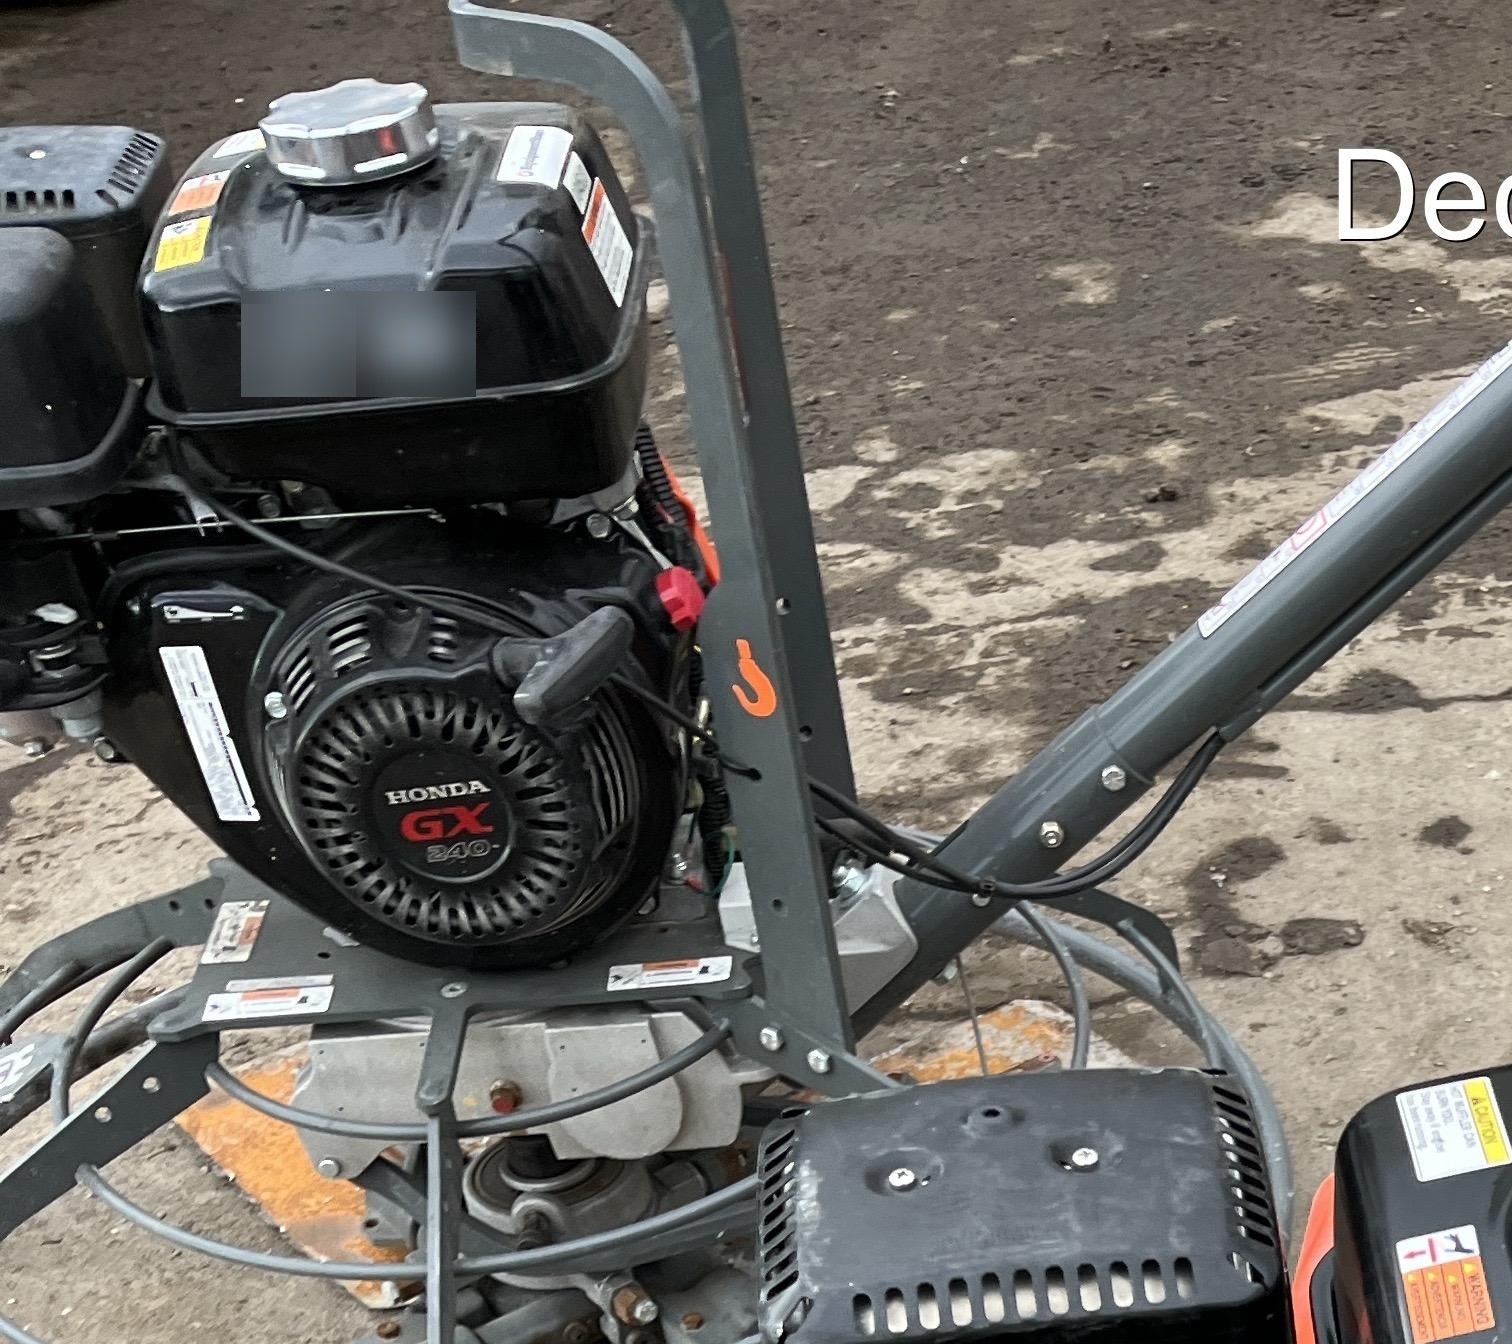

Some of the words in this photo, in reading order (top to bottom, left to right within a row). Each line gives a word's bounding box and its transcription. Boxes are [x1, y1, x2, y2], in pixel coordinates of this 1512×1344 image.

[384, 780, 492, 805] HONDA
[400, 801, 494, 842] GX
[427, 839, 491, 863] 240
